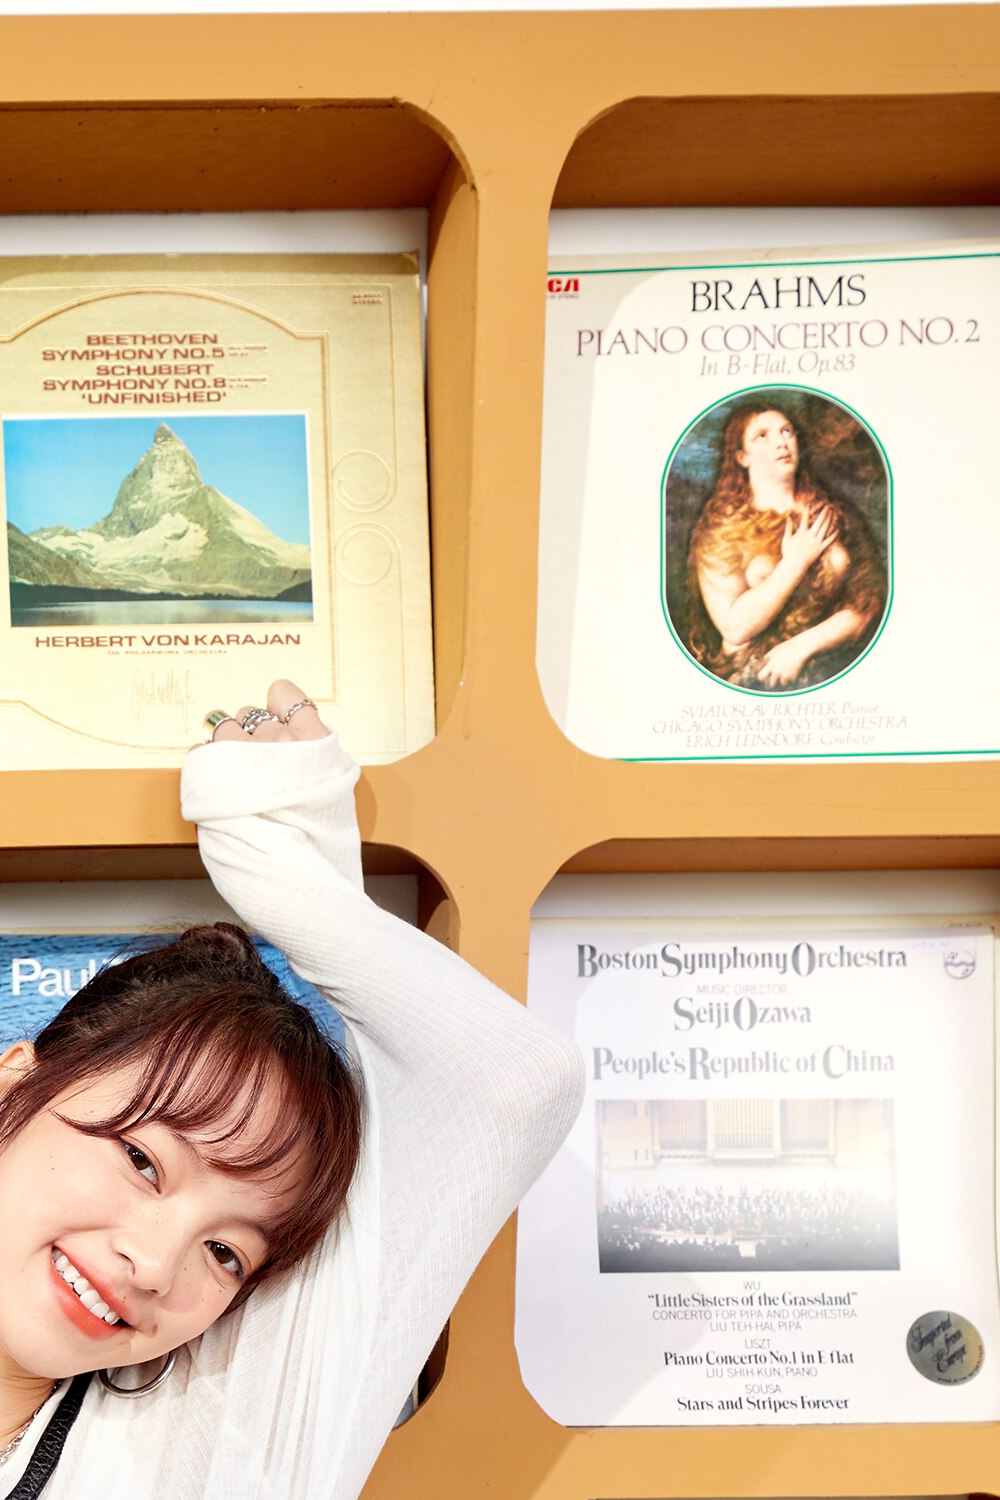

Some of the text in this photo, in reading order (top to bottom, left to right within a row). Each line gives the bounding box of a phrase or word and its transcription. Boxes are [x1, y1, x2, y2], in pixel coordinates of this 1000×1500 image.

[548, 279, 579, 292] CA
[691, 274, 867, 312] BRAHMS
[86, 333, 218, 346] BEETHOVEN
[576, 325, 688, 356] PIANO
[701, 319, 888, 353] CONCERTO
[42, 349, 170, 361] SYMPHONY
[173, 347, 225, 359] NO.5
[96, 364, 214, 376] SCHUBERT
[700, 356, 718, 377] In
[43, 378, 170, 391] SYMPHONY
[174, 377, 227, 389] NO.8
[82, 391, 227, 404] 'UNFINISHED'
[35, 633, 301, 648] HERBERT VON KARAJAN
[576, 941, 908, 978] Boston Symphony Orchestra
[697, 984, 787, 995] MUSIC DIRECTOR
[673, 996, 812, 1031] Seiji Ozawa
[592, 1044, 895, 1081] People's Republic of China
[743, 1281, 761, 1290] WU
[691, 1291, 738, 1307] Sisters
[740, 1291, 756, 1306] of
[758, 1291, 779, 1306] the
[652, 1307, 858, 1321] CONCERTO FOR PIPA AND ORCHESTRA
[663, 1351, 703, 1367] Piano
[706, 1350, 767, 1365] Concerto
[785, 1367, 818, 1377] PIANO
[744, 1384, 782, 1394] SOUSA
[677, 1395, 850, 1414] Stars and Stripes Forever
